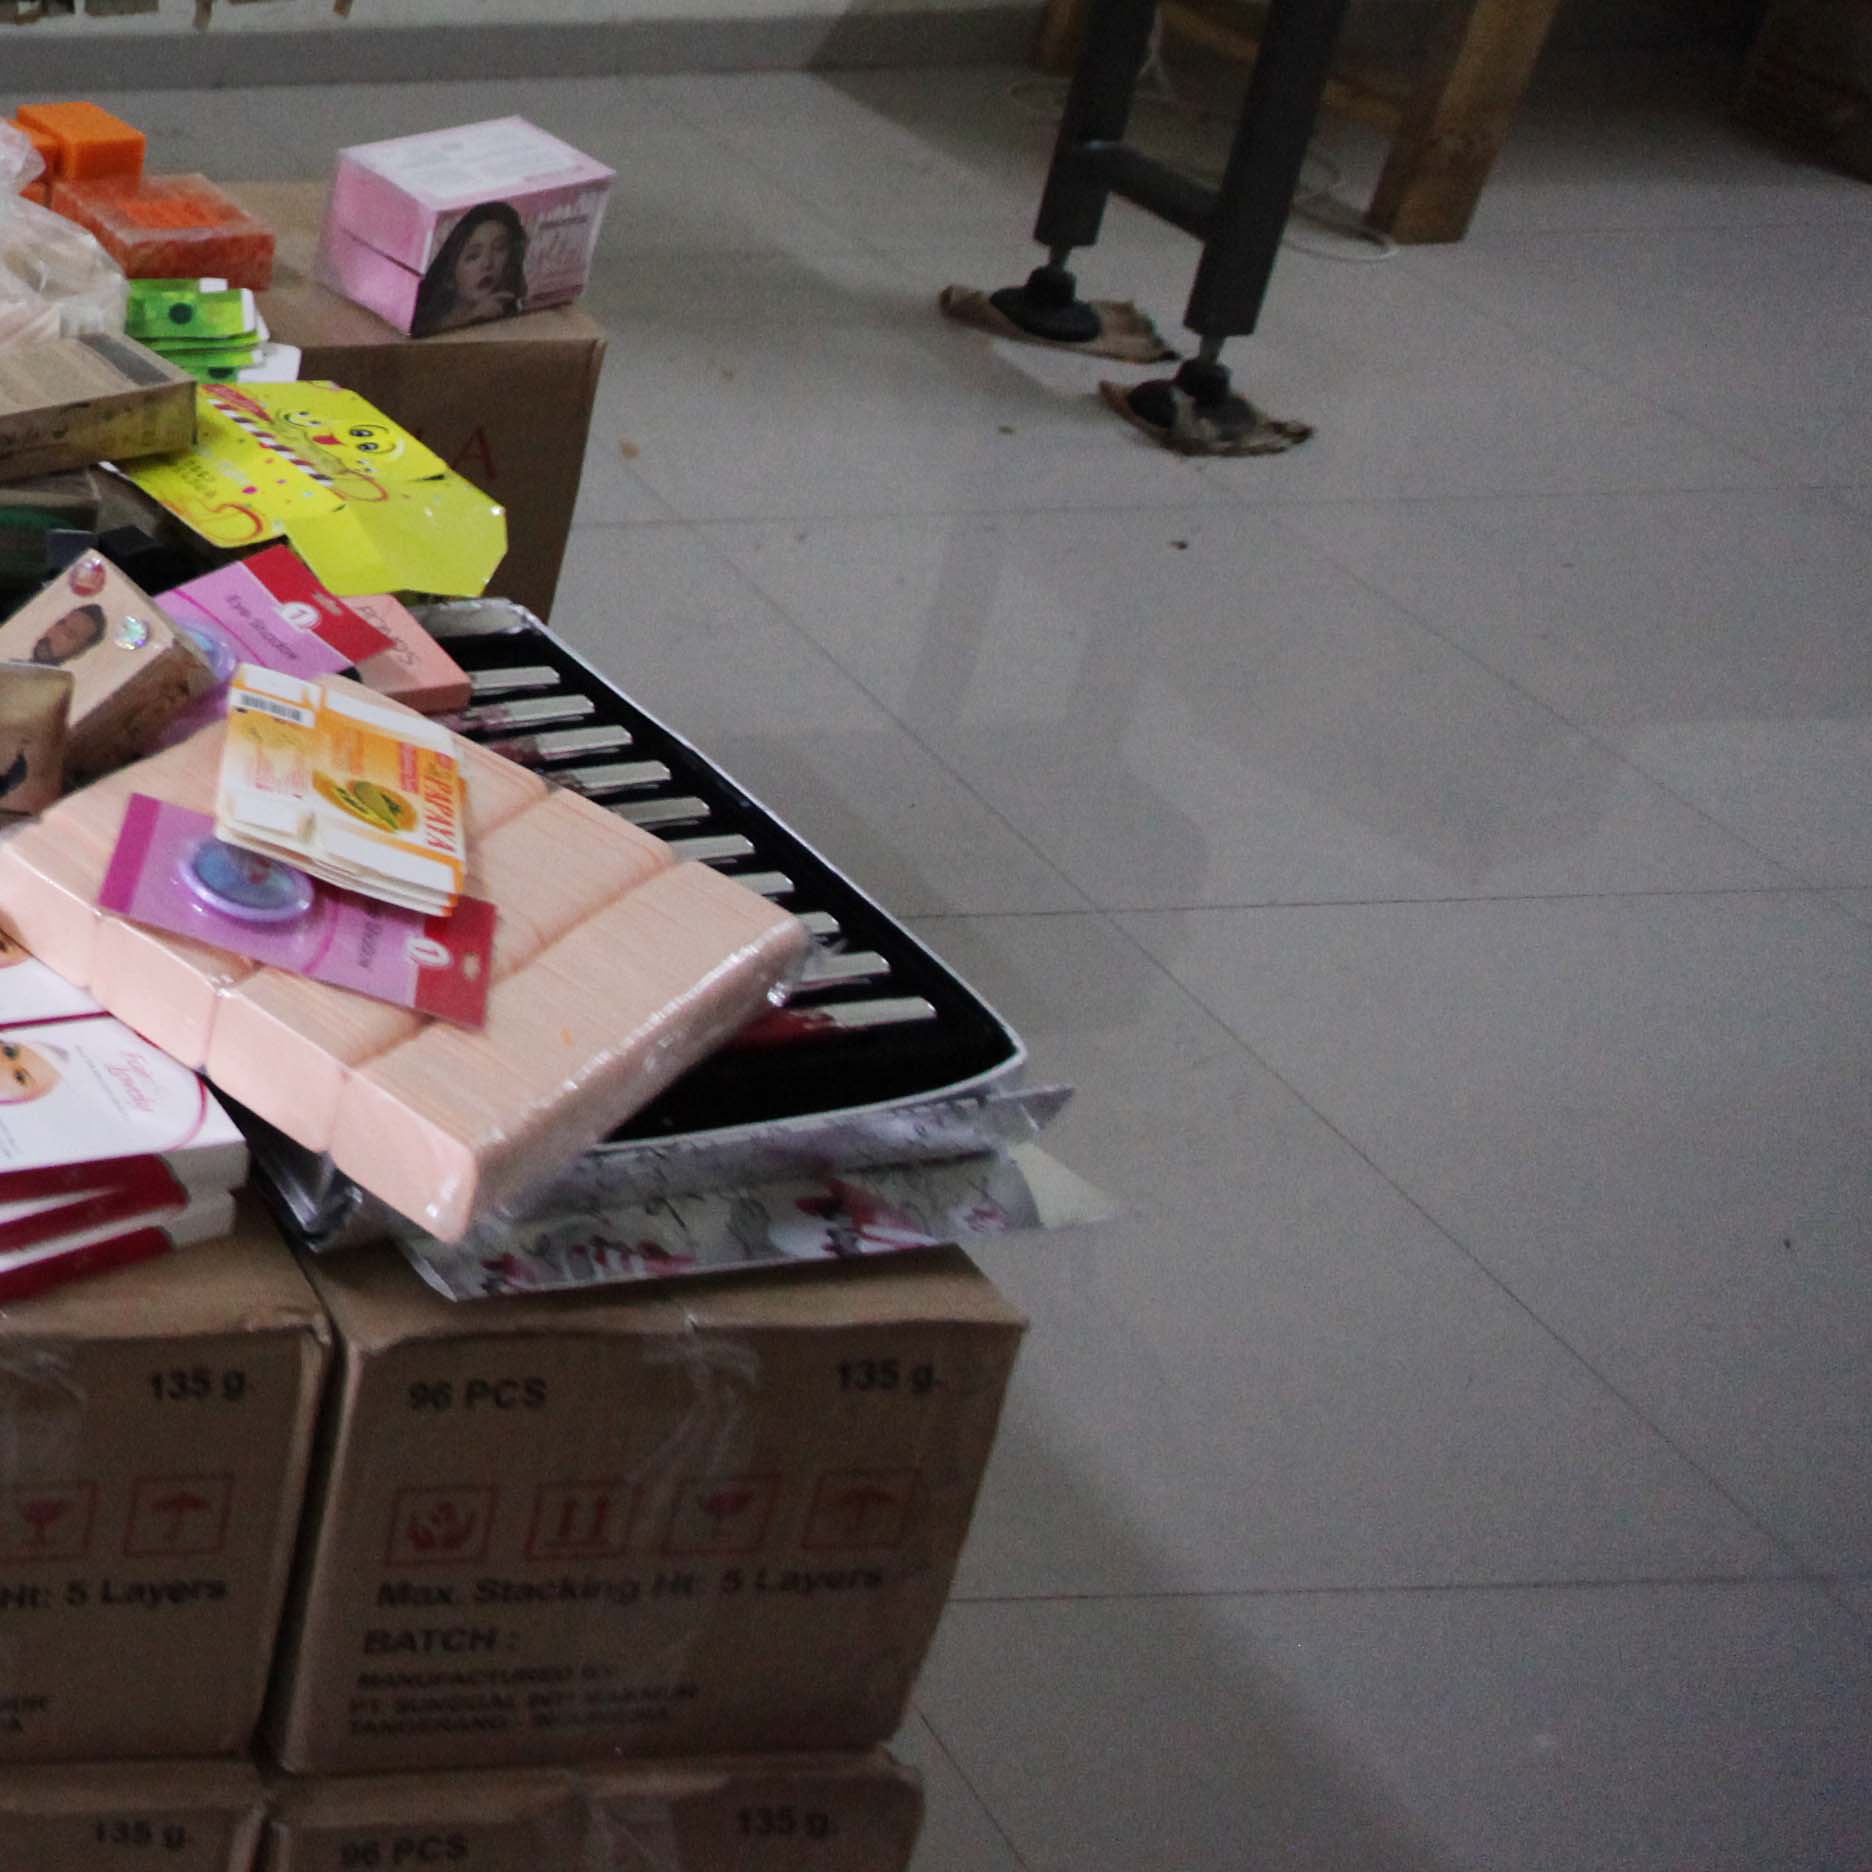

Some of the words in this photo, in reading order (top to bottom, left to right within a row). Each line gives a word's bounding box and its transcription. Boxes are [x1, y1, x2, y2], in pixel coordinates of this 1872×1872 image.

[424, 773, 457, 853] PAPAYA
[151, 1366, 211, 1400] 135
[838, 1358, 900, 1392] 135
[407, 1380, 453, 1411] 96
[464, 1375, 547, 1411] PCS
[63, 1578, 90, 1607] 5
[100, 1577, 230, 1608] Layers
[475, 1575, 642, 1612] Stacking
[719, 1567, 743, 1596] 5
[755, 1566, 884, 1598] Layers
[362, 1627, 498, 1656] BATCH
[94, 1820, 154, 1846] 135
[735, 1807, 796, 1839] 135
[339, 1838, 380, 1867] 96
[390, 1832, 468, 1864] PCS
